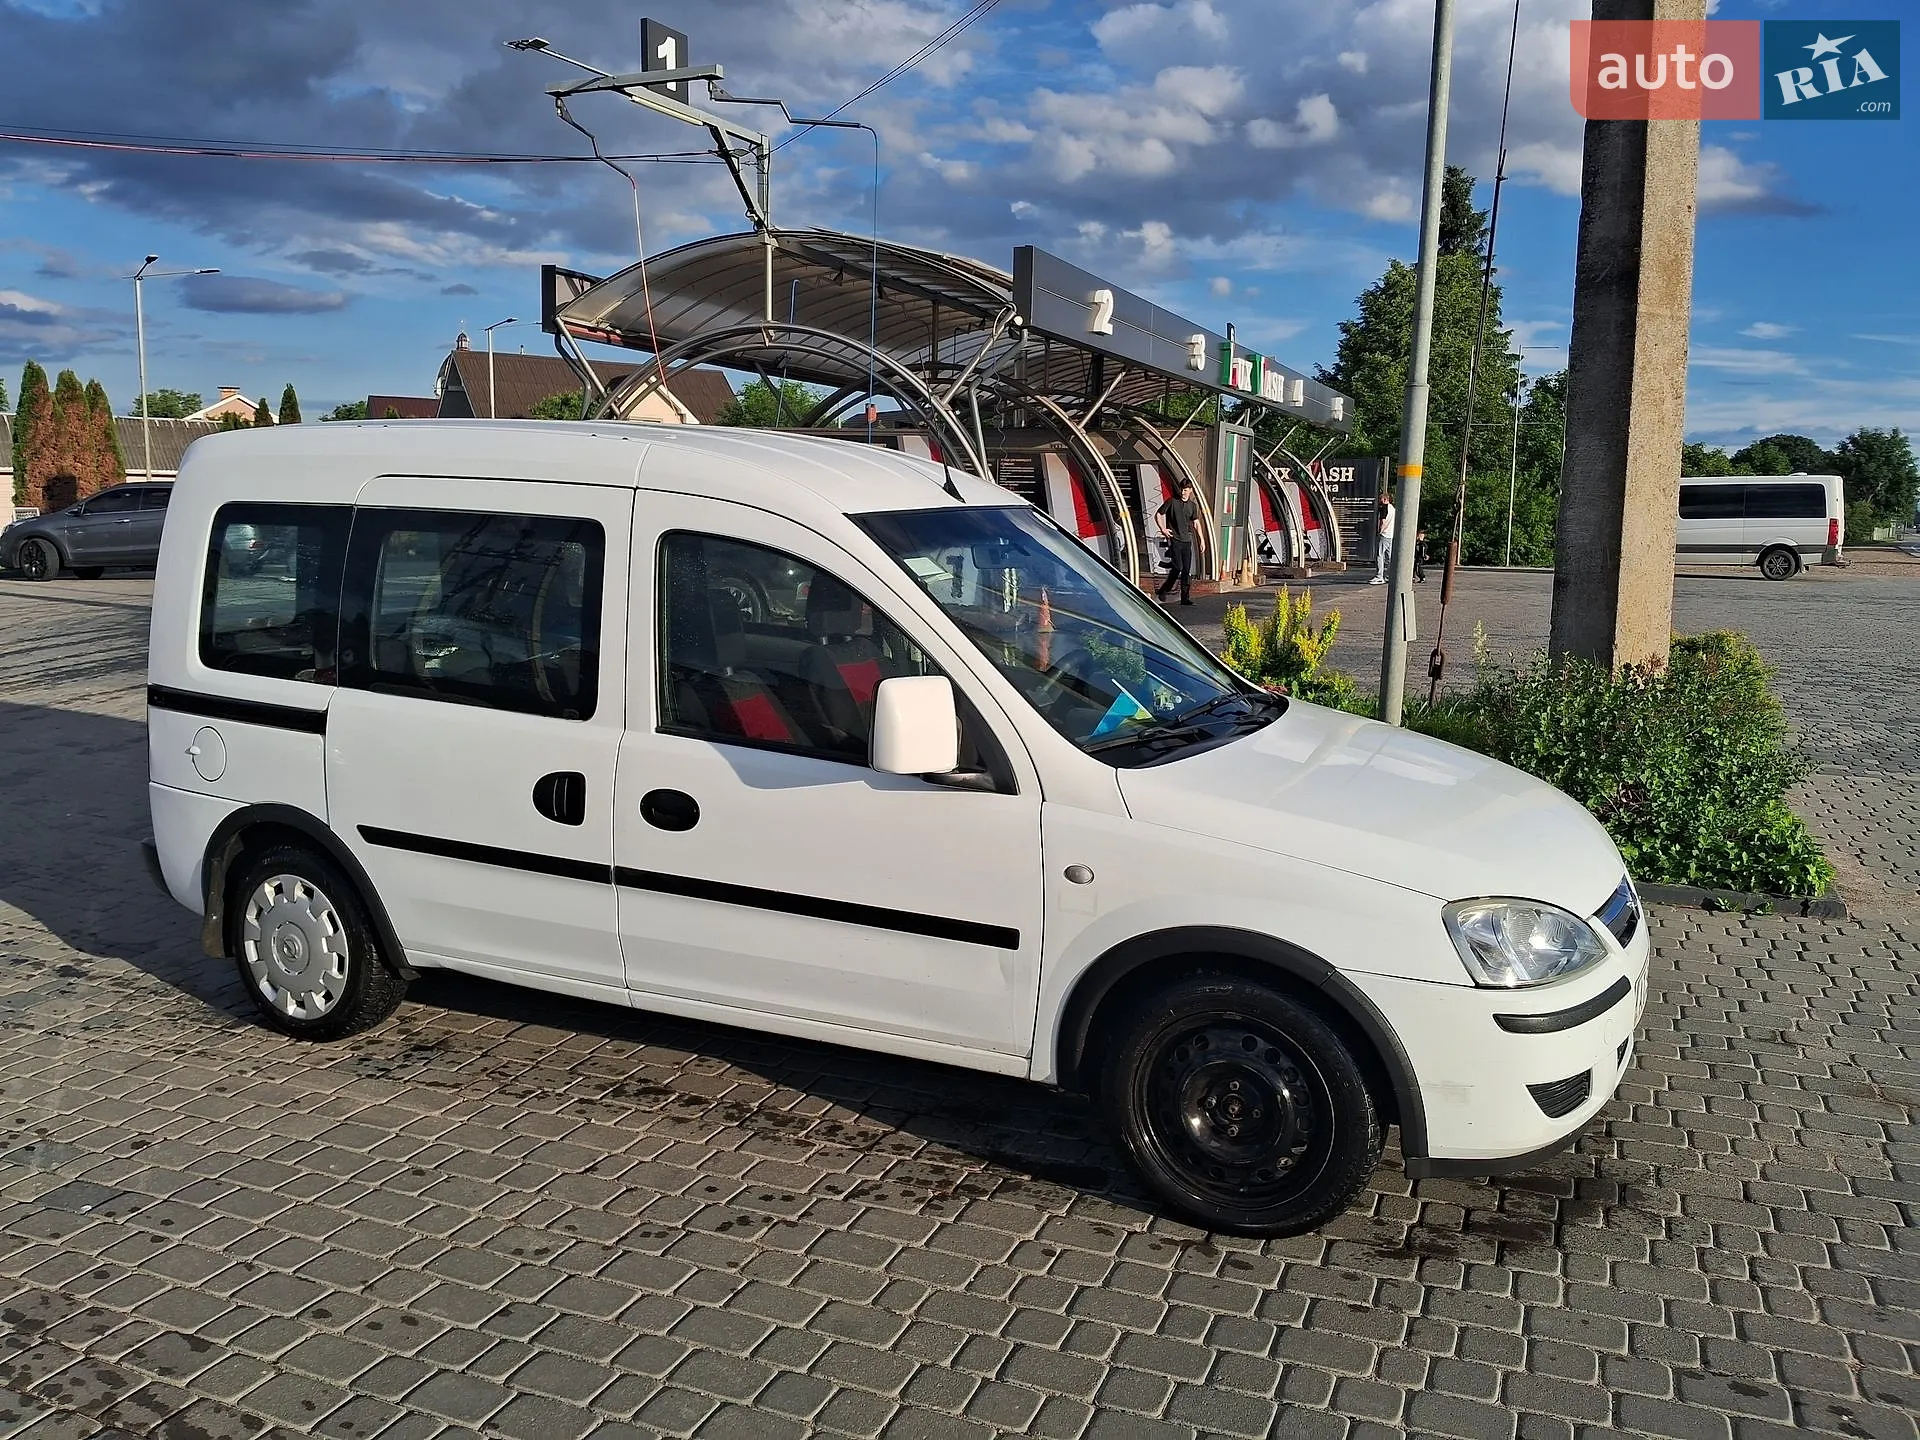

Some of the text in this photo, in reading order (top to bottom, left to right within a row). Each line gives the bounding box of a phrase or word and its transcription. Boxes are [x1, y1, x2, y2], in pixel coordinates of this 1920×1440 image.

[657, 36, 677, 92] 1
[1089, 289, 1114, 336] 2
[1187, 333, 1206, 371] 3
[1290, 379, 1304, 407] 4
